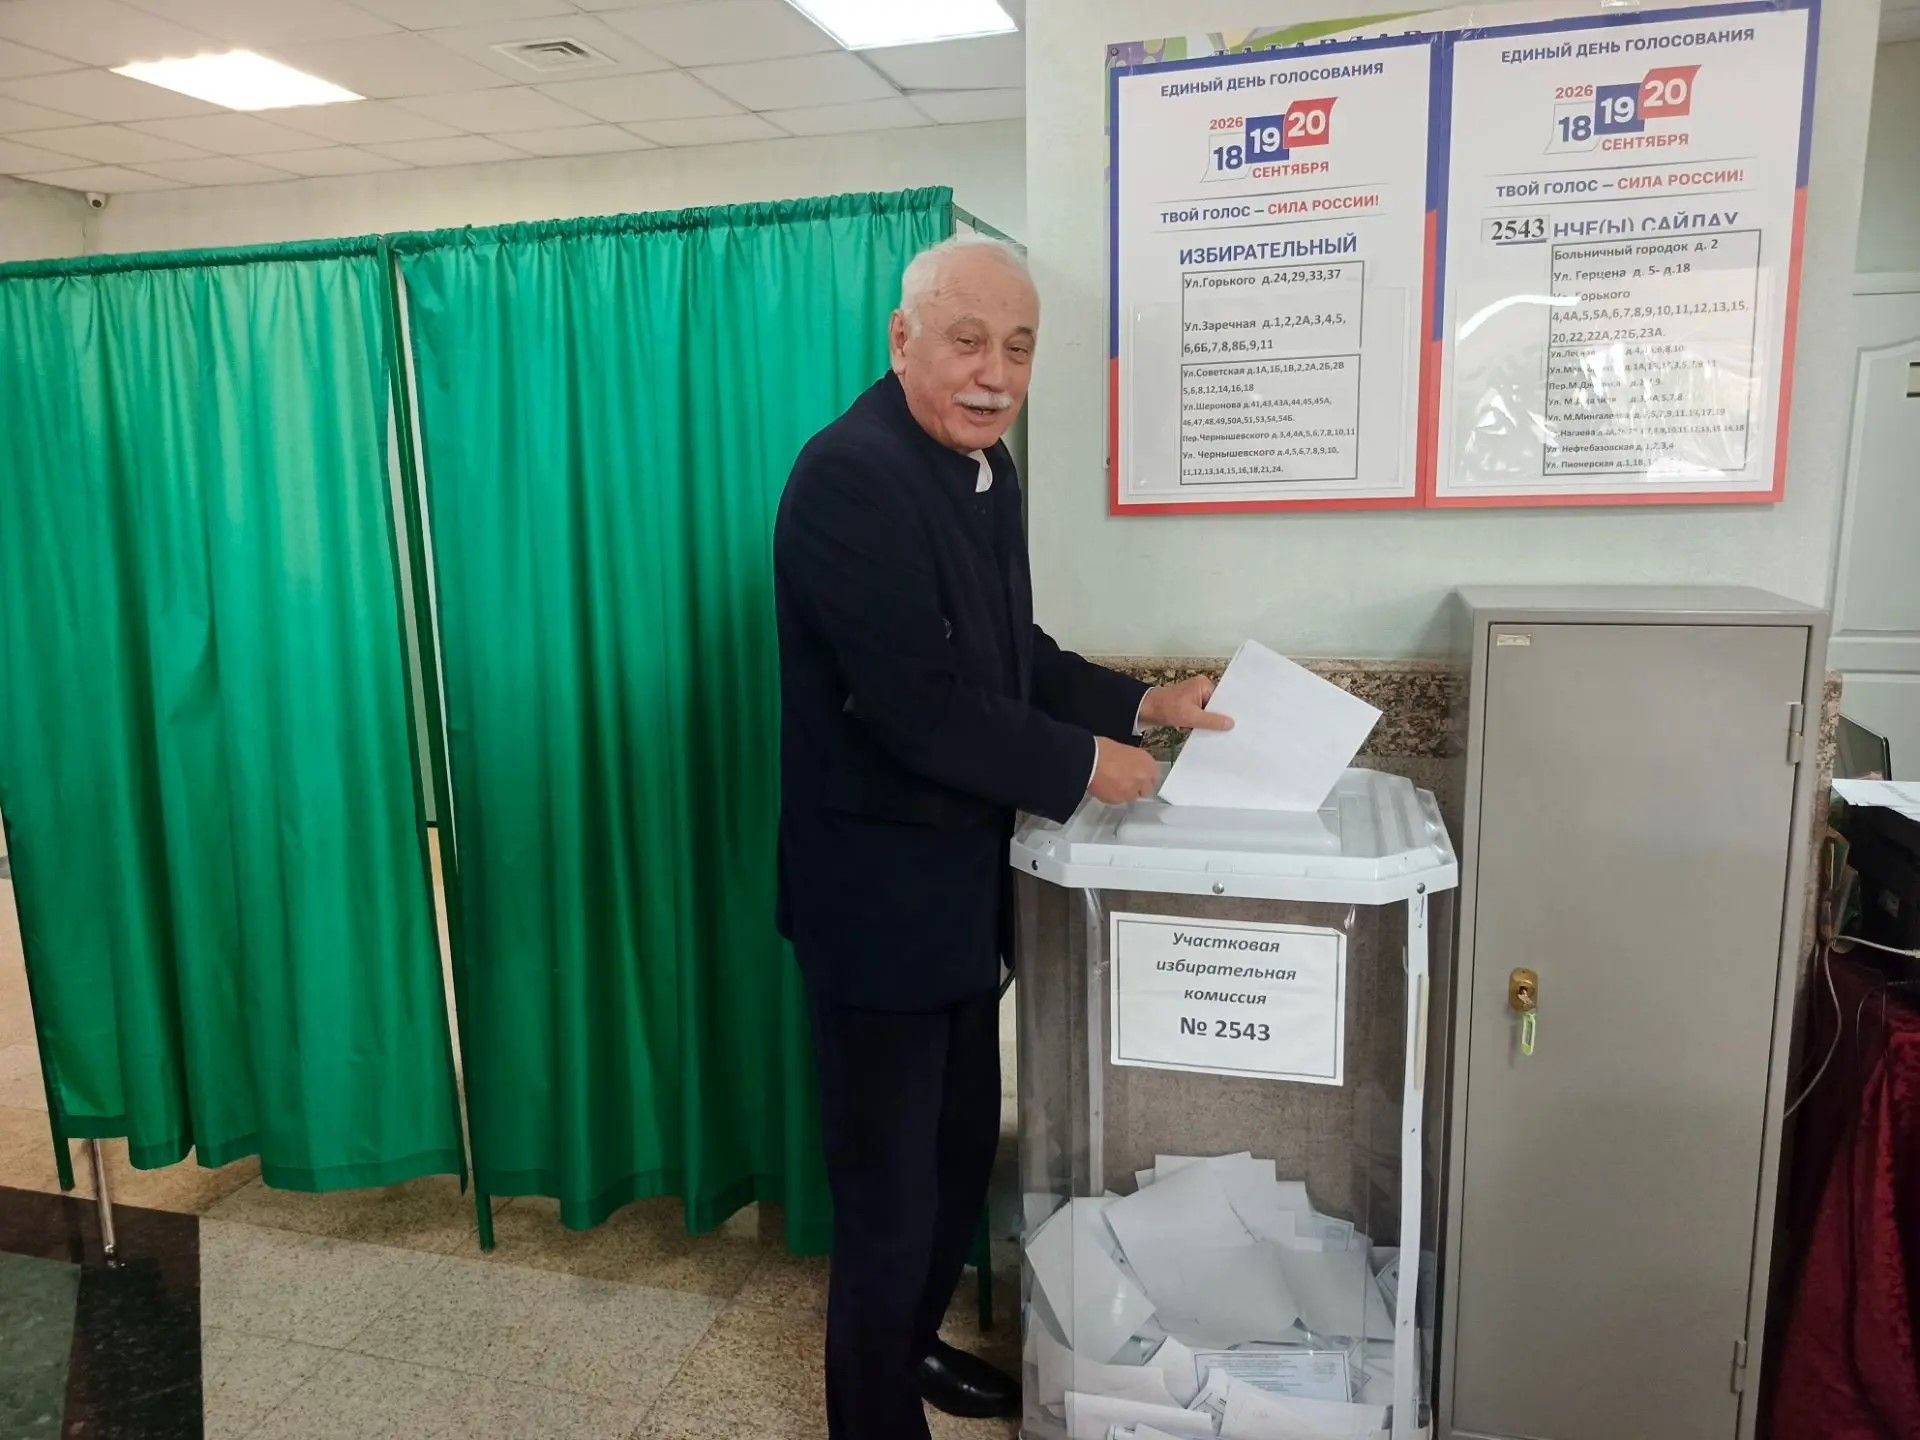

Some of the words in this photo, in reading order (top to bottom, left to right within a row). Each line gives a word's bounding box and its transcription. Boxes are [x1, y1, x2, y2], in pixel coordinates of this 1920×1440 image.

[1501, 43, 1572, 63] ЕДИНЫЙ
[1576, 38, 1620, 57] ДЕНЬ
[1626, 28, 1754, 52] ГОЛОСОВАНИЯ
[1161, 77, 1223, 97] ЕДИНЫЙ
[1227, 73, 1266, 92] ДЕНЬ
[1270, 62, 1384, 86] ГОЛОСОВАНИЯ
[1555, 85, 1593, 99] 2026
[1558, 115, 1592, 142] 18
[1600, 96, 1634, 124] 19
[1644, 78, 1687, 107] 20
[1209, 116, 1244, 130] 2026
[1213, 144, 1243, 171] 18
[1250, 126, 1281, 153] 19
[1288, 109, 1326, 137] 20
[1602, 133, 1688, 151] СЕНТЯБРЯ
[1252, 161, 1329, 179] СЕНТЯБРЯ
[1496, 179, 1539, 197] ТВОЙ
[1543, 180, 1598, 195] ГОЛОС
[1618, 174, 1662, 189] СИЛА
[1668, 169, 1744, 187] РОССИИ!
[1160, 207, 1199, 224] ТВОЙ
[1203, 206, 1250, 221] ГОЛОС
[1268, 198, 1308, 215] СИЛА
[1312, 194, 1379, 212] РОССИИ!
[1491, 218, 1546, 241] 2543
[1179, 232, 1357, 265] ИЗБИРАТЕЛЬНЫЙ
[1554, 244, 1633, 261] Больничный
[1636, 241, 1689, 256] городок
[1694, 242, 1708, 252] д.
[1711, 239, 1719, 249] 2
[1184, 276, 1256, 290] Ул.Горького
[1262, 269, 1341, 286] д.24,29,33,37
[1553, 271, 1573, 283] Ул.
[1575, 268, 1627, 282] Герцена
[1663, 263, 1691, 276] д.18
[1184, 319, 1256, 332] Ул.Заречная
[1262, 313, 1347, 330] д.1,2,2А,3,4,5,
[1184, 339, 1273, 354] 6,6Б,7,8,8Б,9,11
[1183, 367, 1245, 379] Ул.Советская
[1183, 383, 1254, 396] 5,6,8,12,14,16,18
[1183, 401, 1241, 412] Ул.Шеронова
[1182, 431, 1270, 443] Пер.Чернышевского
[1182, 451, 1196, 460] Ул.
[1198, 448, 1275, 460] Чернышевского
[1562, 442, 1635, 454] Нефтебазовская
[1561, 459, 1614, 470] Пионерская
[1172, 932, 1280, 953] Участковая
[1156, 959, 1297, 981] избирательная
[1184, 987, 1267, 1005] комиссия
[1180, 1016, 1208, 1036] №
[1214, 1020, 1271, 1042] 2543
